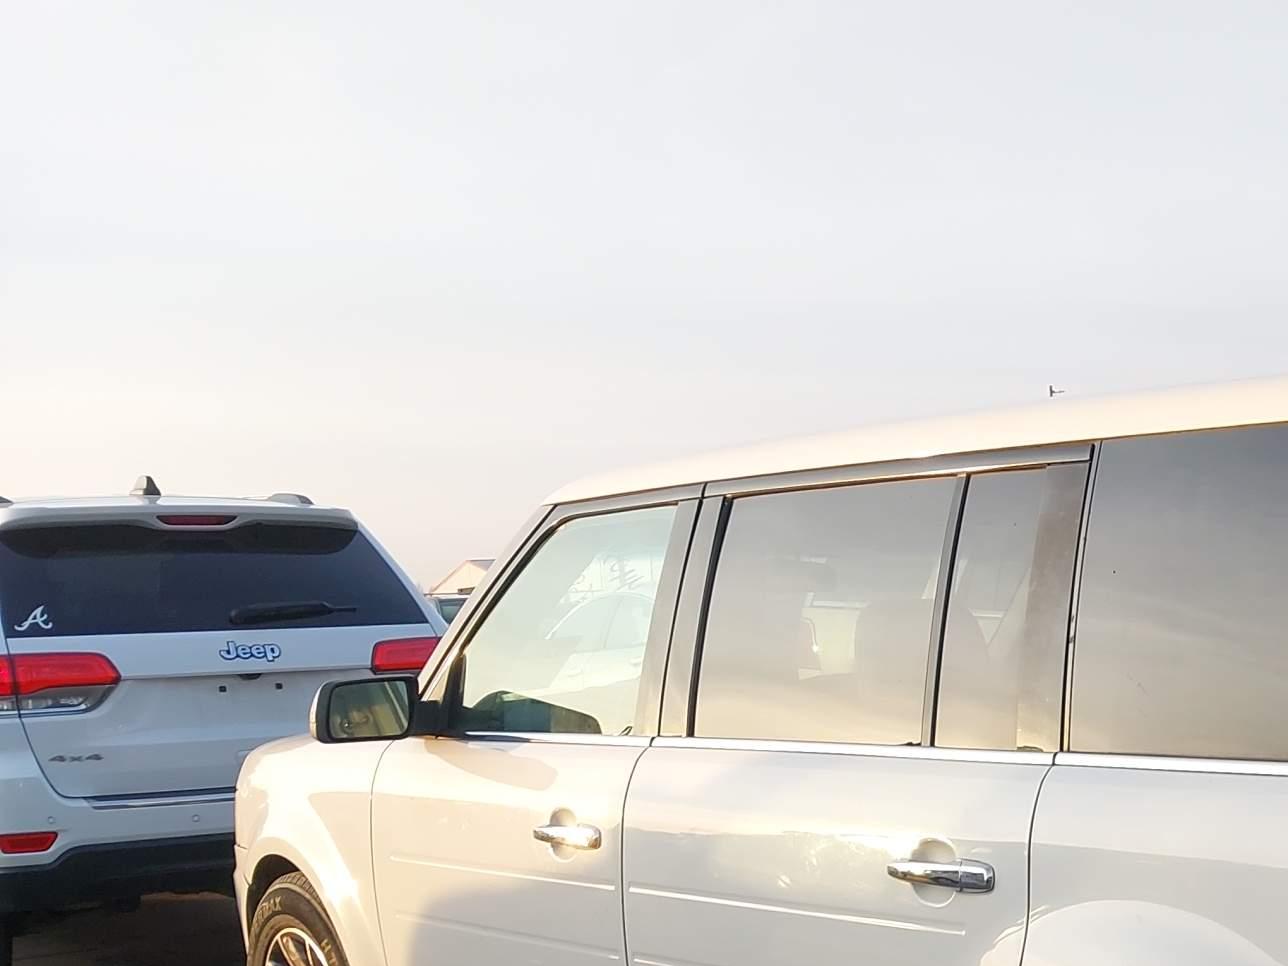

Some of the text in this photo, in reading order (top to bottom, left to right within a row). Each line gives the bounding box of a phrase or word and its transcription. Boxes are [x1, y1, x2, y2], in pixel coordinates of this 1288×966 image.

[14, 605, 53, 631] A
[219, 640, 281, 662] Jeep
[48, 753, 104, 763] 4x4
